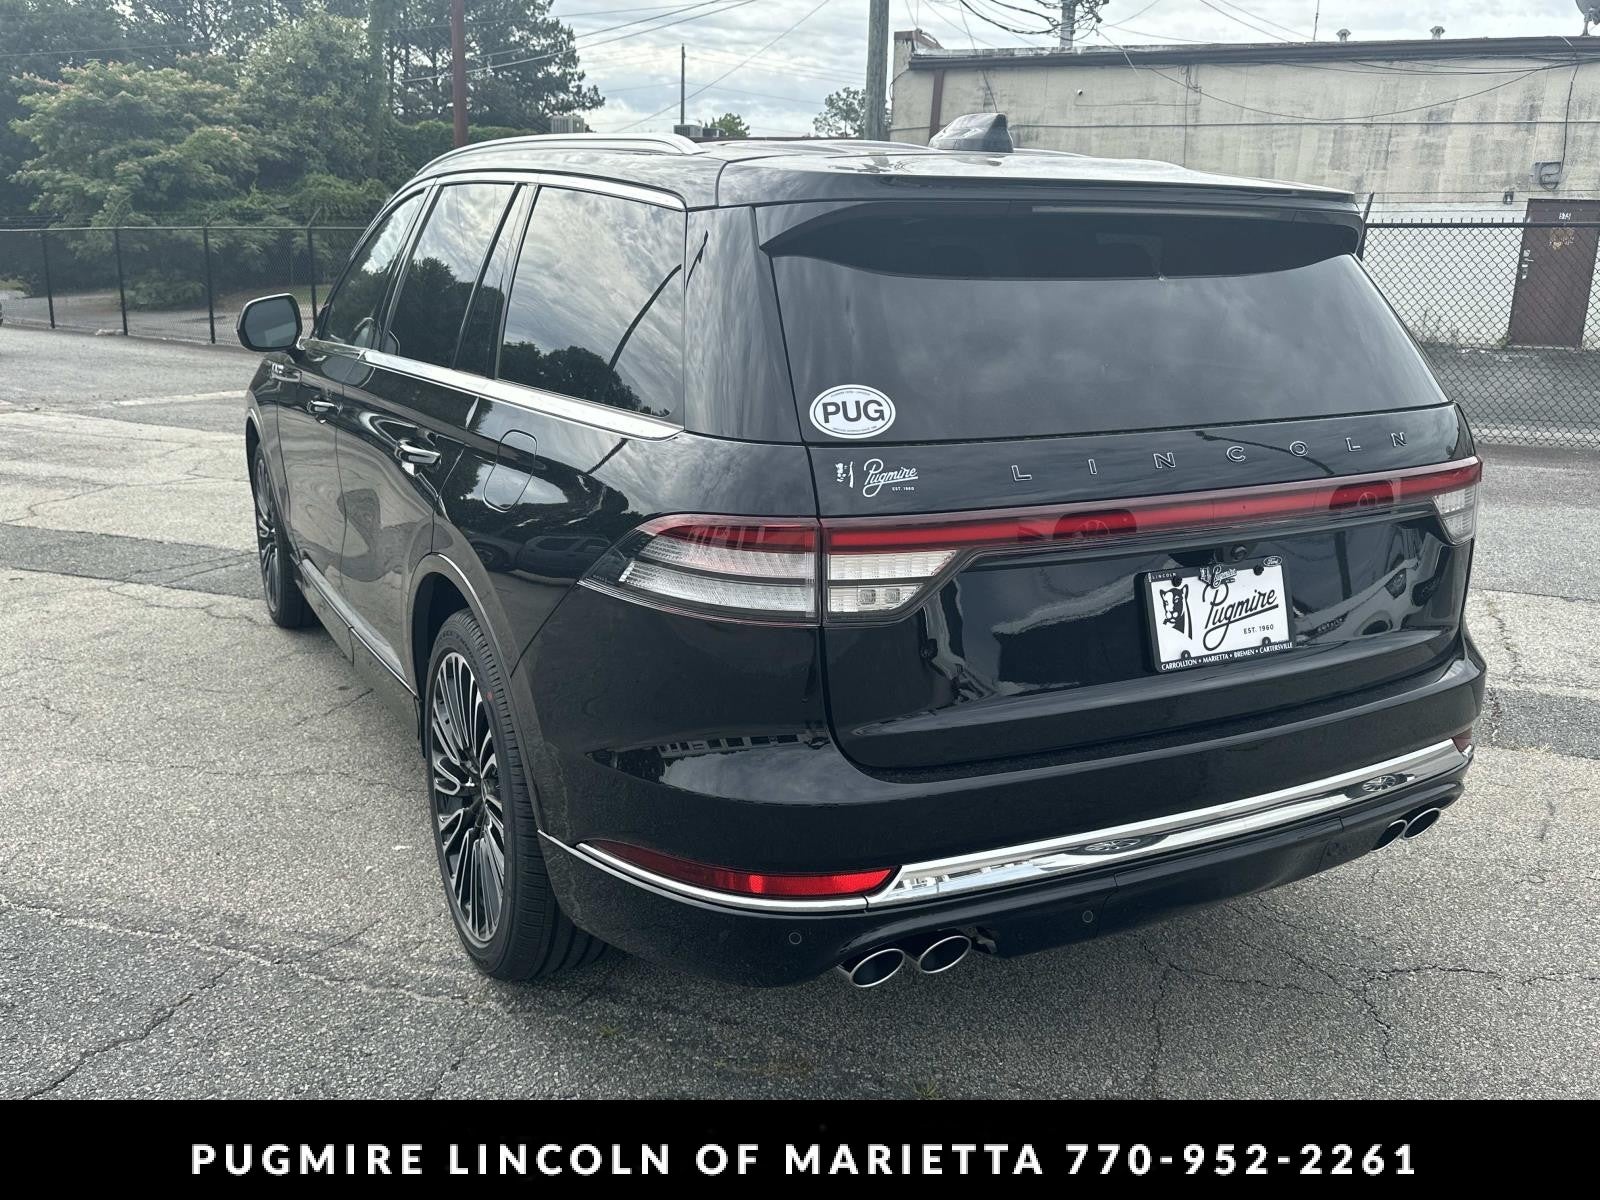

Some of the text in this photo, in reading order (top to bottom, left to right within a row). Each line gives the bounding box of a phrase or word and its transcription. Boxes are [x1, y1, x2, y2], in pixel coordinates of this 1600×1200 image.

[822, 399, 886, 424] PUG
[1011, 431, 1408, 482] LINCOLN
[862, 458, 919, 498] Pugmire
[1202, 582, 1279, 652] Pugmire
[1243, 623, 1274, 635] EST. 1960
[1161, 658, 1198, 671] CARROLLTON
[1202, 653, 1229, 664] MARIETTA
[1233, 648, 1255, 658] BREMEN
[1259, 642, 1293, 654] CARTERSVILLE
